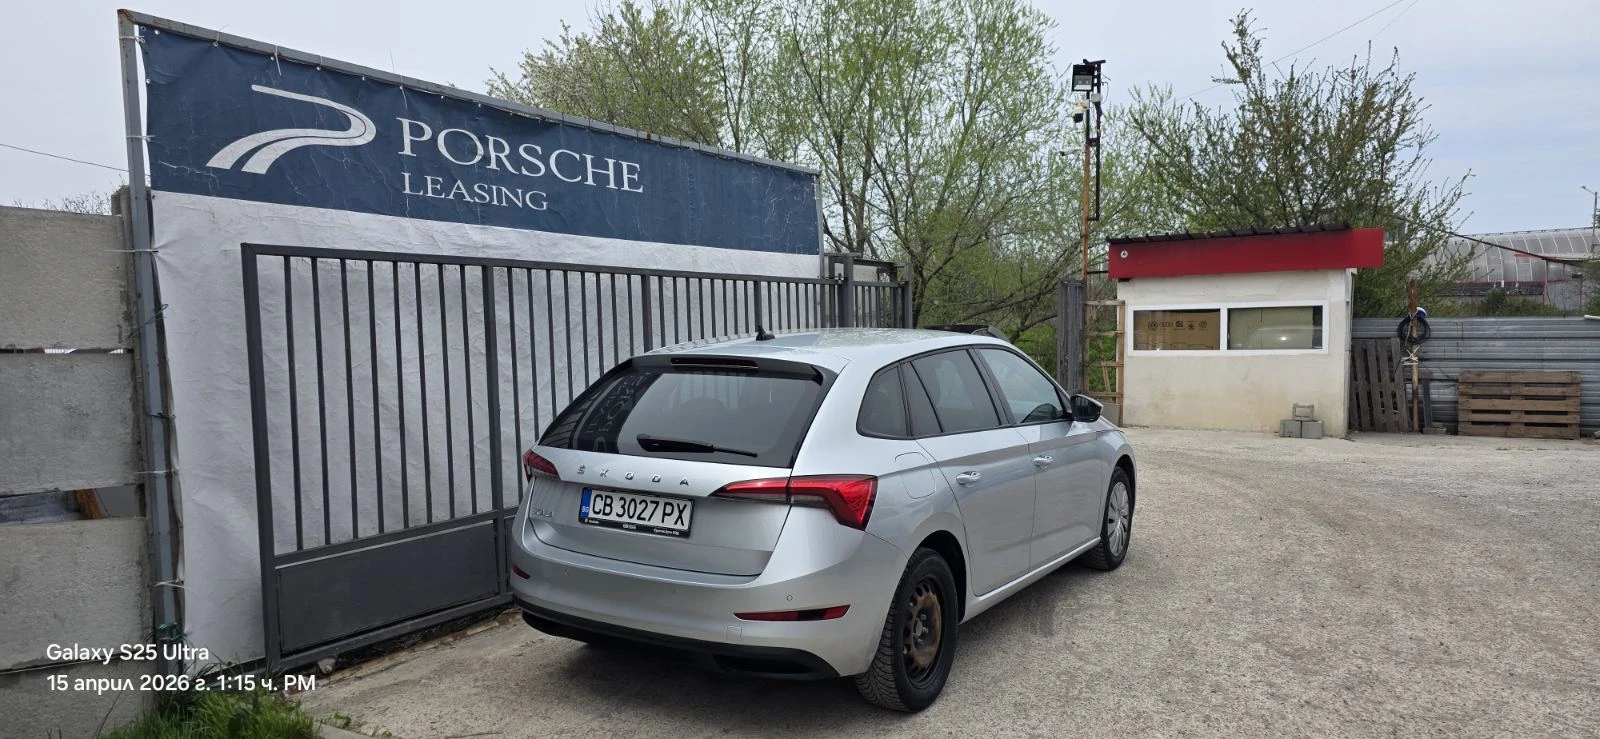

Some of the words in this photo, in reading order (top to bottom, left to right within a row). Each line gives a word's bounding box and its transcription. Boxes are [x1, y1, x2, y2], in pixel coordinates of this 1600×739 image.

[396, 117, 644, 193] PORSCHE
[401, 172, 549, 211] LEASING
[592, 493, 614, 517] CB
[616, 496, 660, 522] 3027
[661, 501, 688, 526] PX
